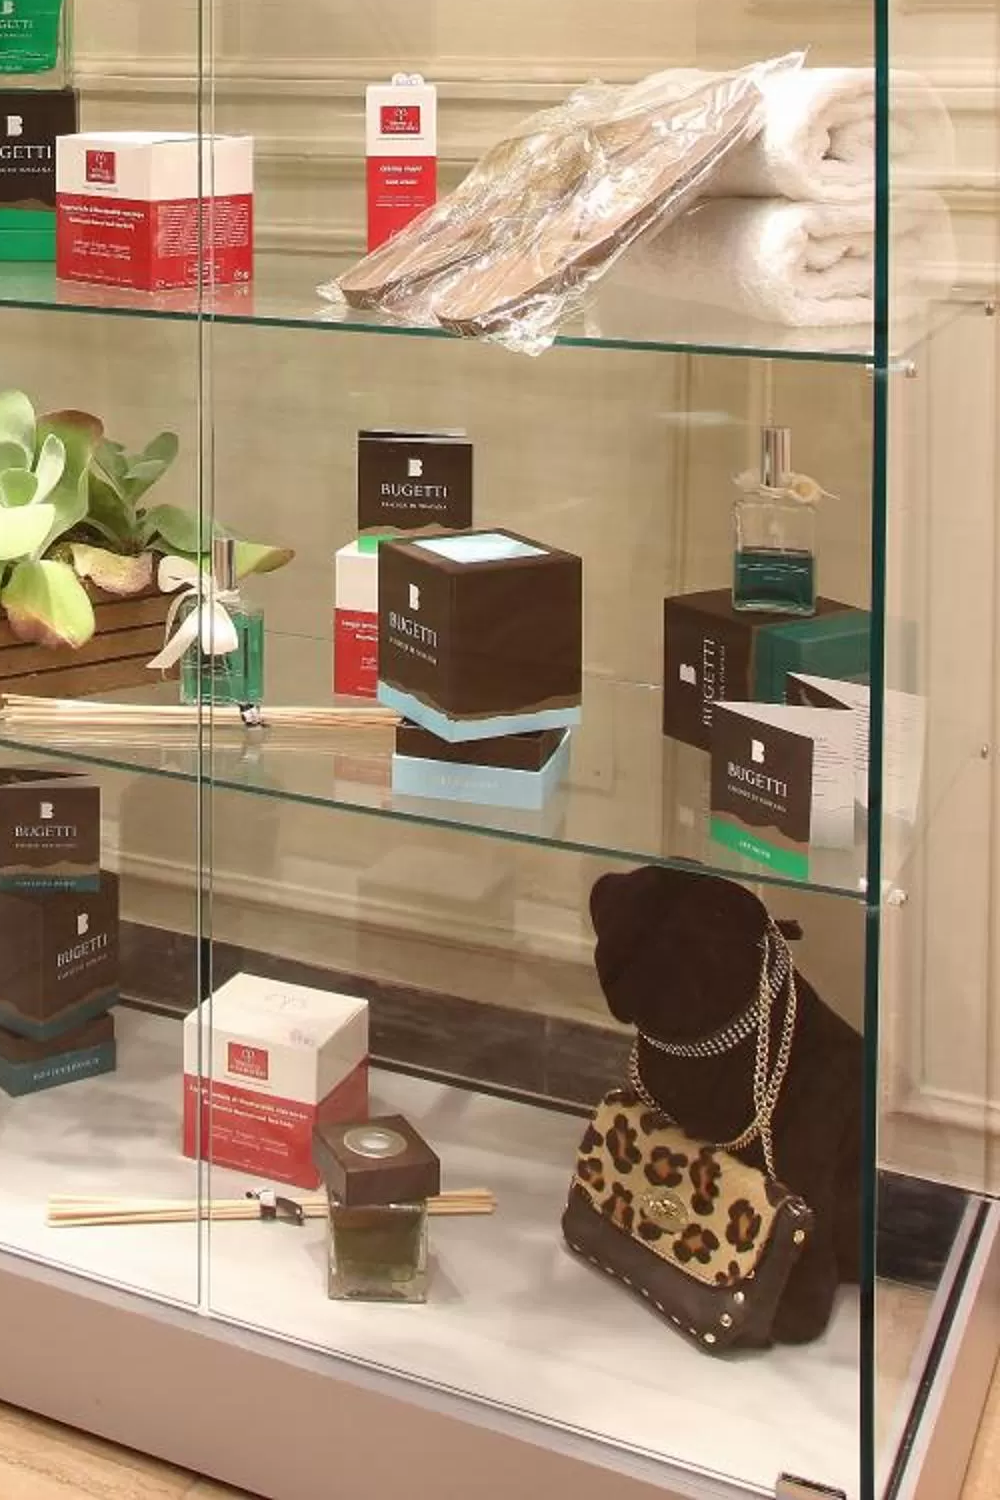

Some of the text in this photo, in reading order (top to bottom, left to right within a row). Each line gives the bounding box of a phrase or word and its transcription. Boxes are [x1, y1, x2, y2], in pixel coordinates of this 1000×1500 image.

[6, 115, 24, 137] B
[408, 458, 424, 478] B
[380, 483, 449, 499] BUGETTI
[388, 610, 438, 649] BUGETTI
[750, 738, 766, 764] B
[727, 760, 788, 798] BUGETTI
[40, 801, 55, 819] B
[15, 825, 77, 837] BUGETTI
[56, 932, 108, 968] BUGETTI
